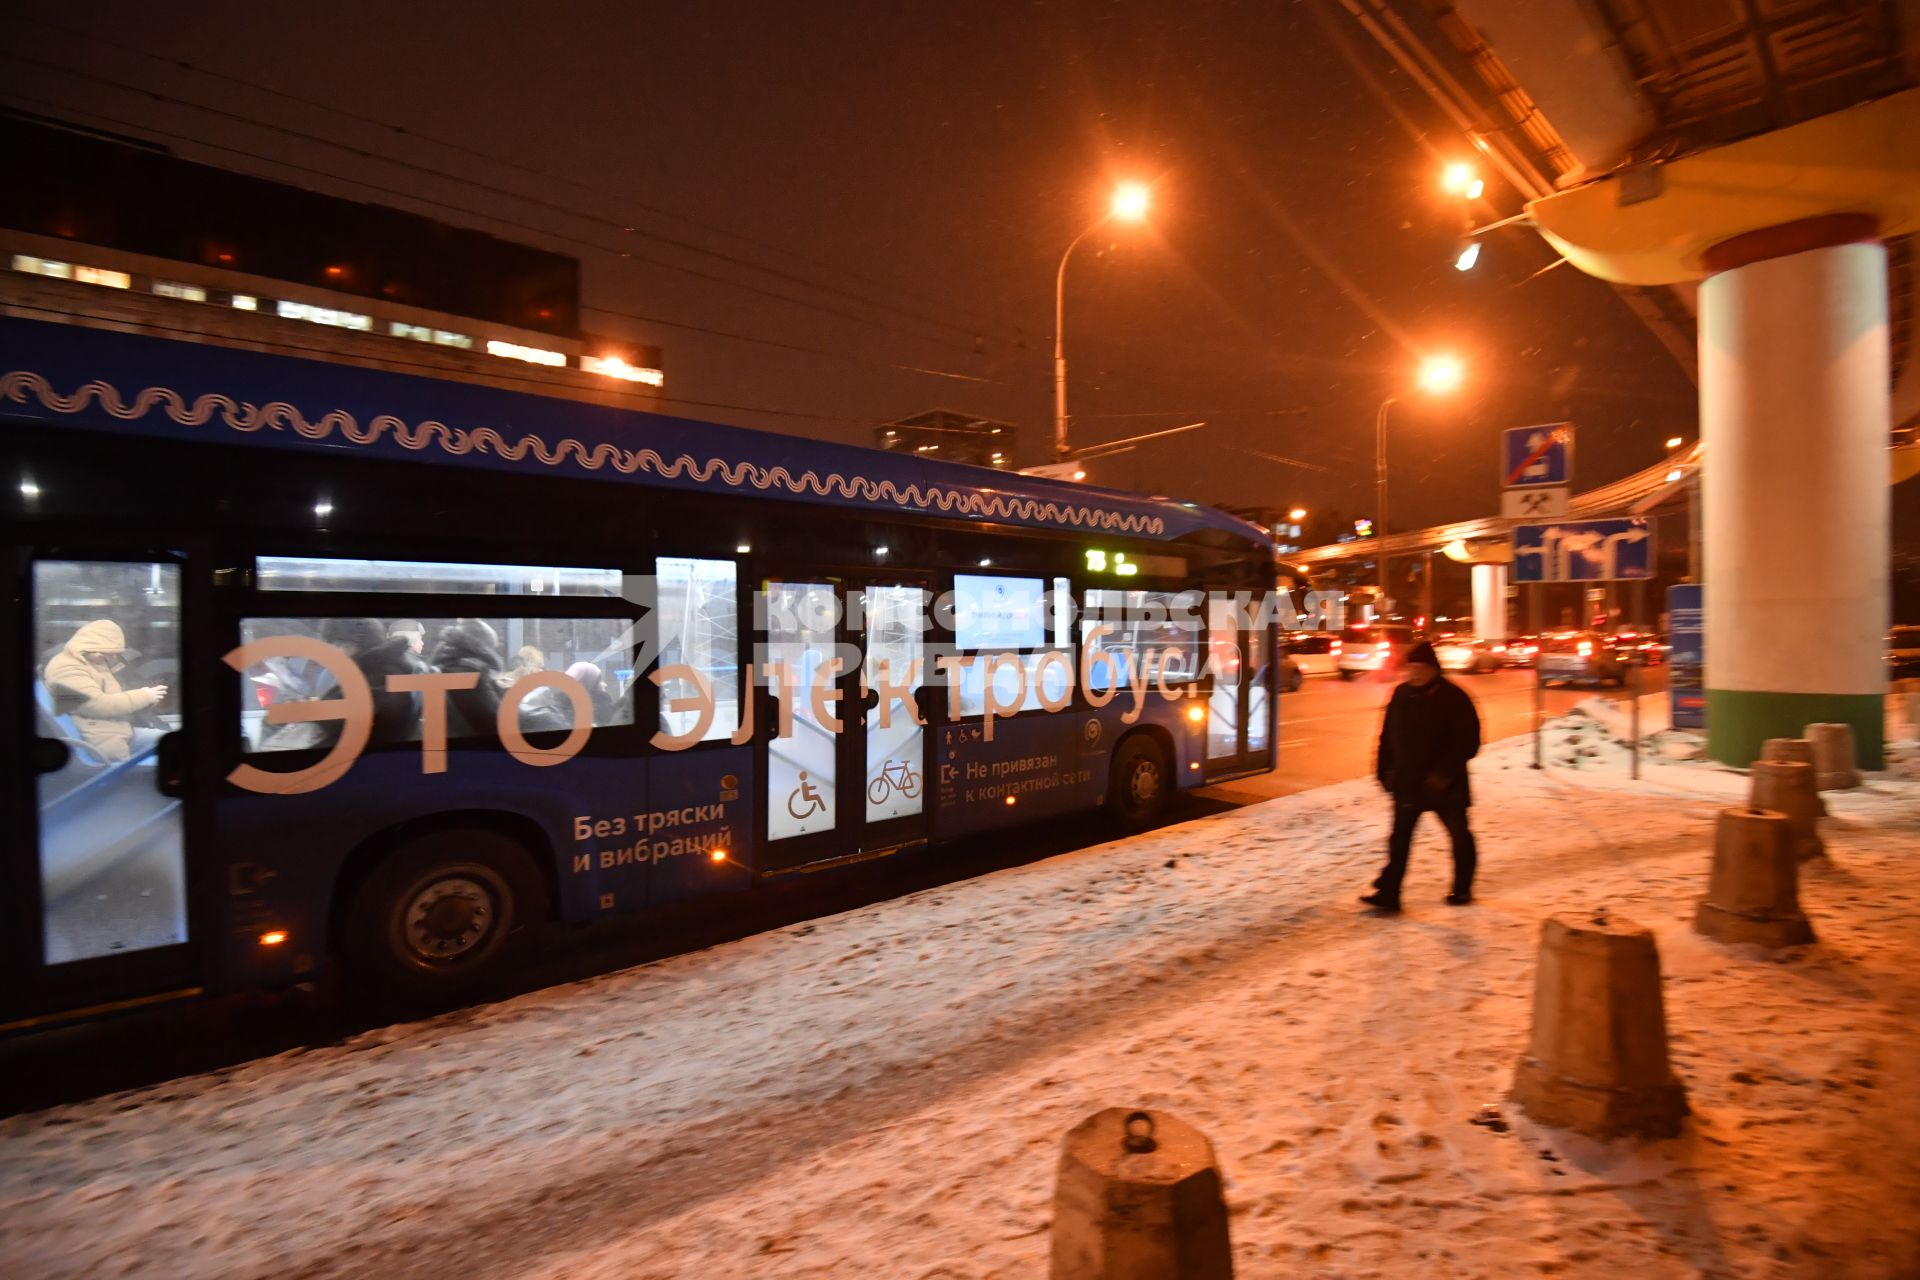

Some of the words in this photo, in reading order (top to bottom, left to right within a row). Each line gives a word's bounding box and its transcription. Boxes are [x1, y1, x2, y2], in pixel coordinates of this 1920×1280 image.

[221, 635, 593, 794] Это
[966, 762, 988, 780] Не
[991, 755, 1057, 778] привязан
[966, 789, 975, 802] к
[978, 773, 1059, 801] контактной
[1063, 769, 1092, 785] сети
[573, 816, 626, 842] Без
[633, 803, 725, 835] тряски
[573, 852, 591, 873] и
[599, 826, 733, 871] вибраций
